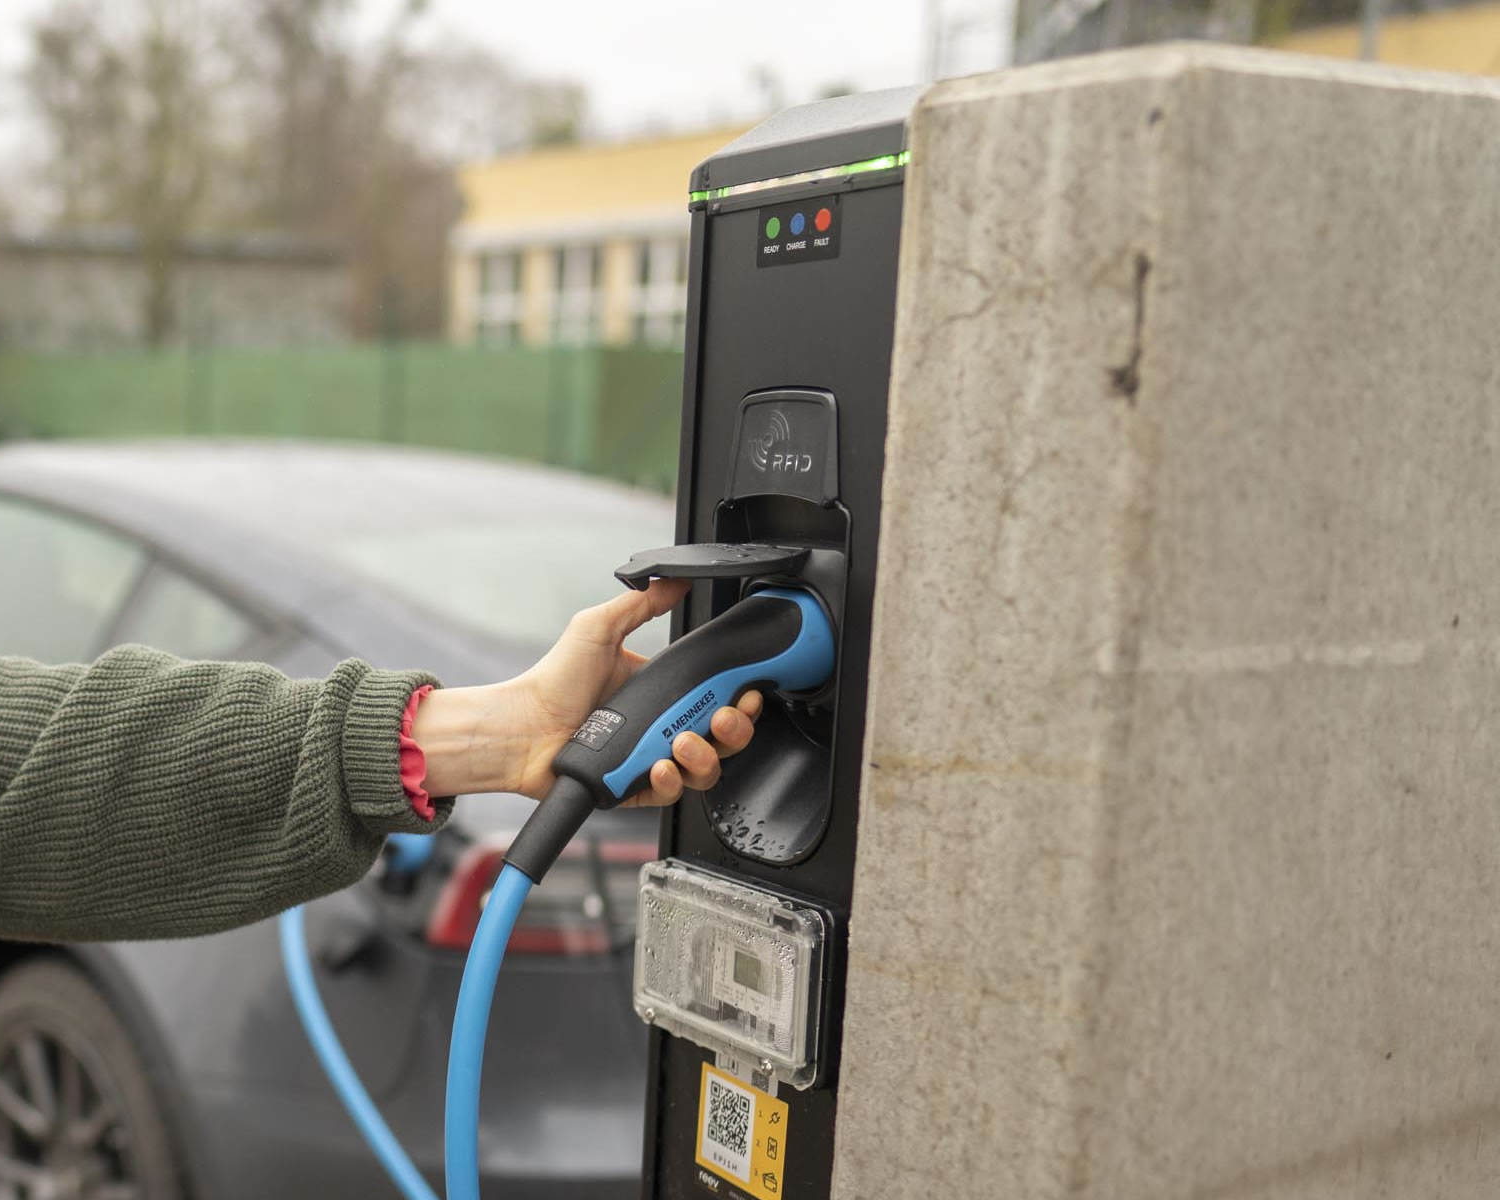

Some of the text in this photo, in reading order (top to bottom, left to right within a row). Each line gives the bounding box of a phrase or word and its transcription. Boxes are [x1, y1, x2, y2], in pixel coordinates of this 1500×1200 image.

[764, 237, 830, 254] READY CHARGE FAULT
[772, 454, 812, 472] RFID
[671, 690, 715, 732] MENNEKES
